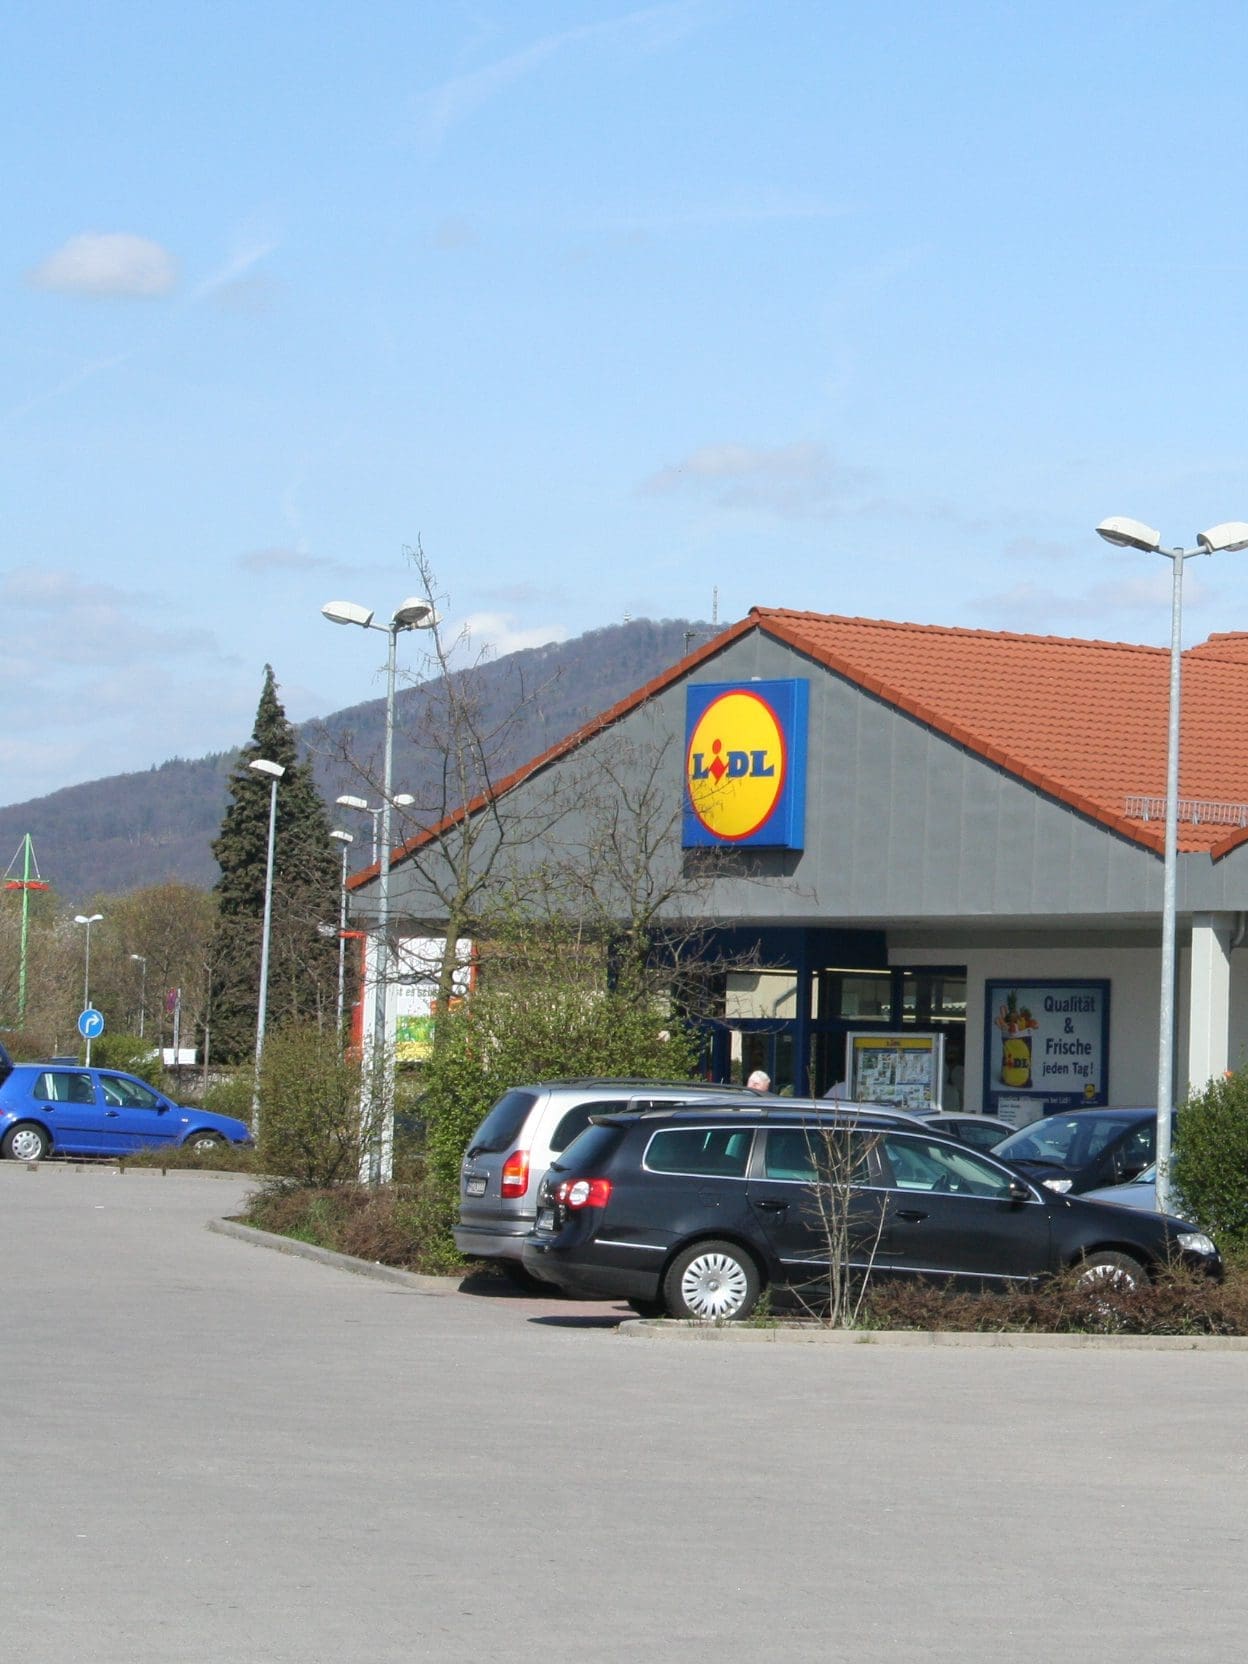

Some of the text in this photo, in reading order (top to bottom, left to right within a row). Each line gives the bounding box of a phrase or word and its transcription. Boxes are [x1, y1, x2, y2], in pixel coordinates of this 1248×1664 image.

[1044, 995, 1096, 1013] Qualität
[1064, 1017, 1075, 1034] &
[1046, 1038, 1092, 1056] Frische
[1042, 1062, 1069, 1077] jeden
